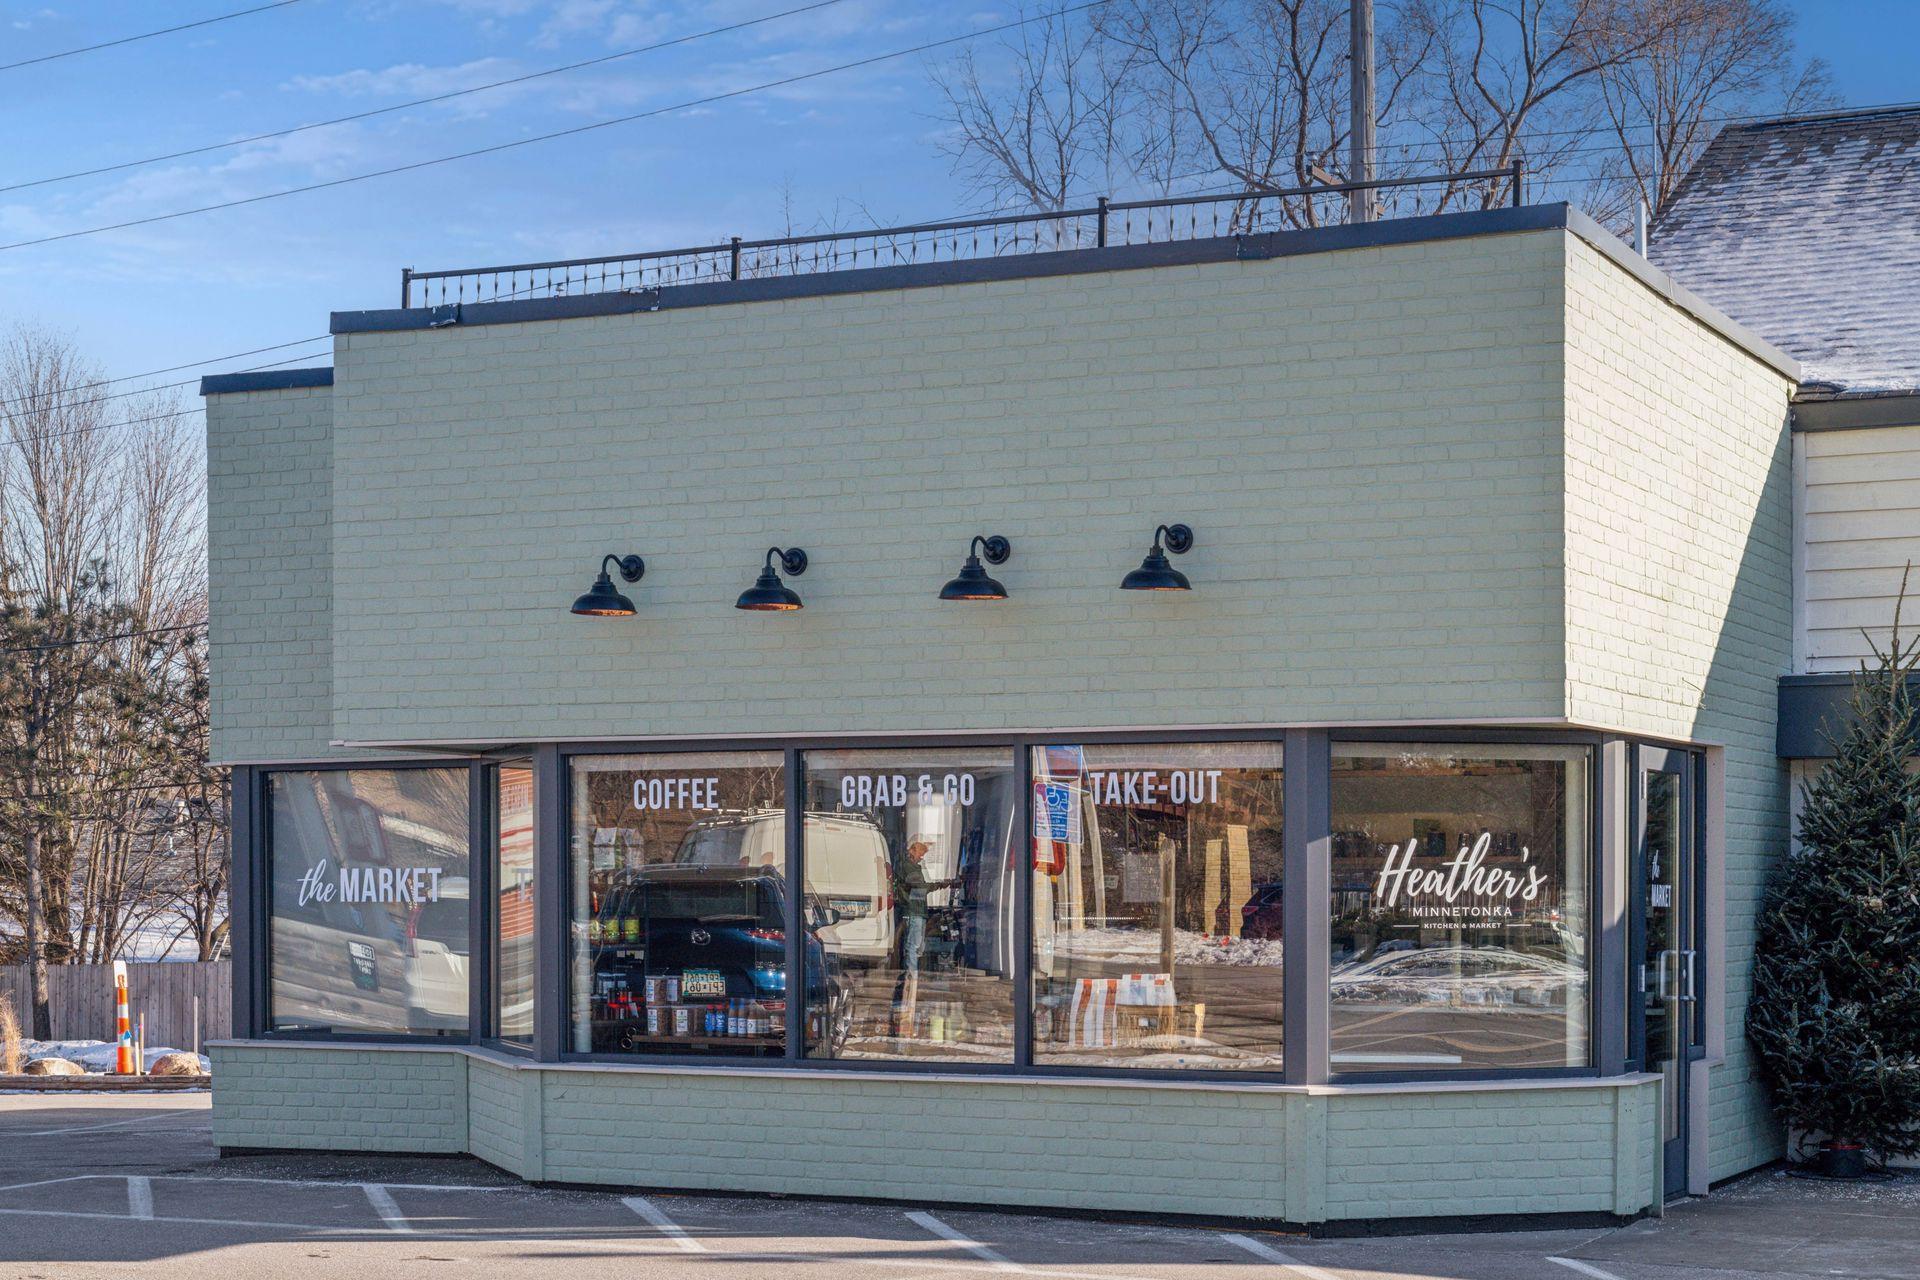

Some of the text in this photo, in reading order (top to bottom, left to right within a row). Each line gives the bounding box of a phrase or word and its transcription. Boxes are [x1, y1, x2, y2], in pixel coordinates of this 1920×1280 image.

[634, 778, 719, 810] COFFEE
[841, 773, 975, 807] GRAB & GO
[1090, 771, 1222, 805] TAKE-OUT
[296, 858, 442, 908] the MARKET
[1376, 832, 1548, 907] Heather's
[1412, 907, 1512, 917] MINNETONKA
[1651, 884, 1671, 907] MARKET
[1423, 922, 1460, 930] KITCHEN
[1469, 922, 1502, 930] MARKET
